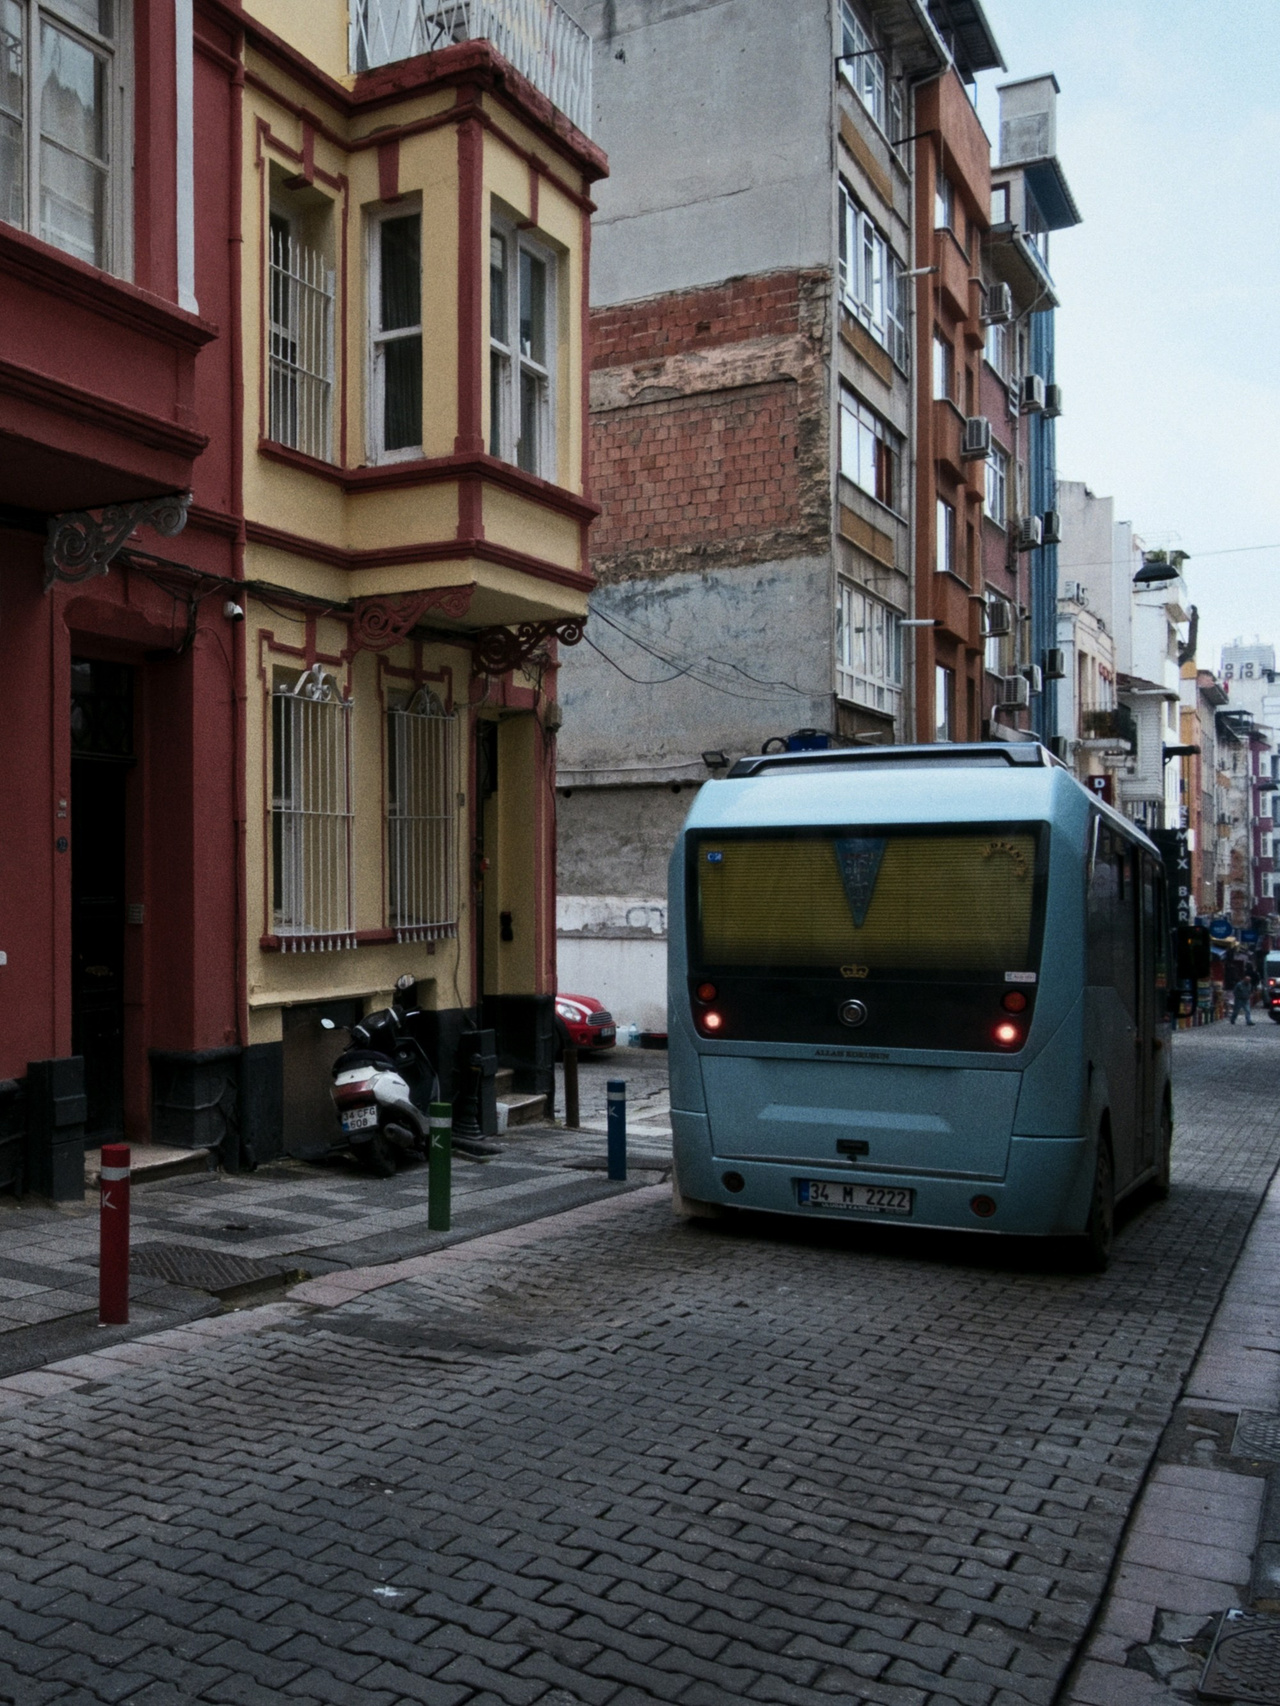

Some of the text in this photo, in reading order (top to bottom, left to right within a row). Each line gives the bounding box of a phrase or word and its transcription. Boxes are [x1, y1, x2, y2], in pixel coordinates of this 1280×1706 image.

[1177, 886, 1189, 921] BAR
[810, 1182, 829, 1201] 34
[843, 1186, 854, 1203] M
[866, 1188, 907, 1208] 2222
